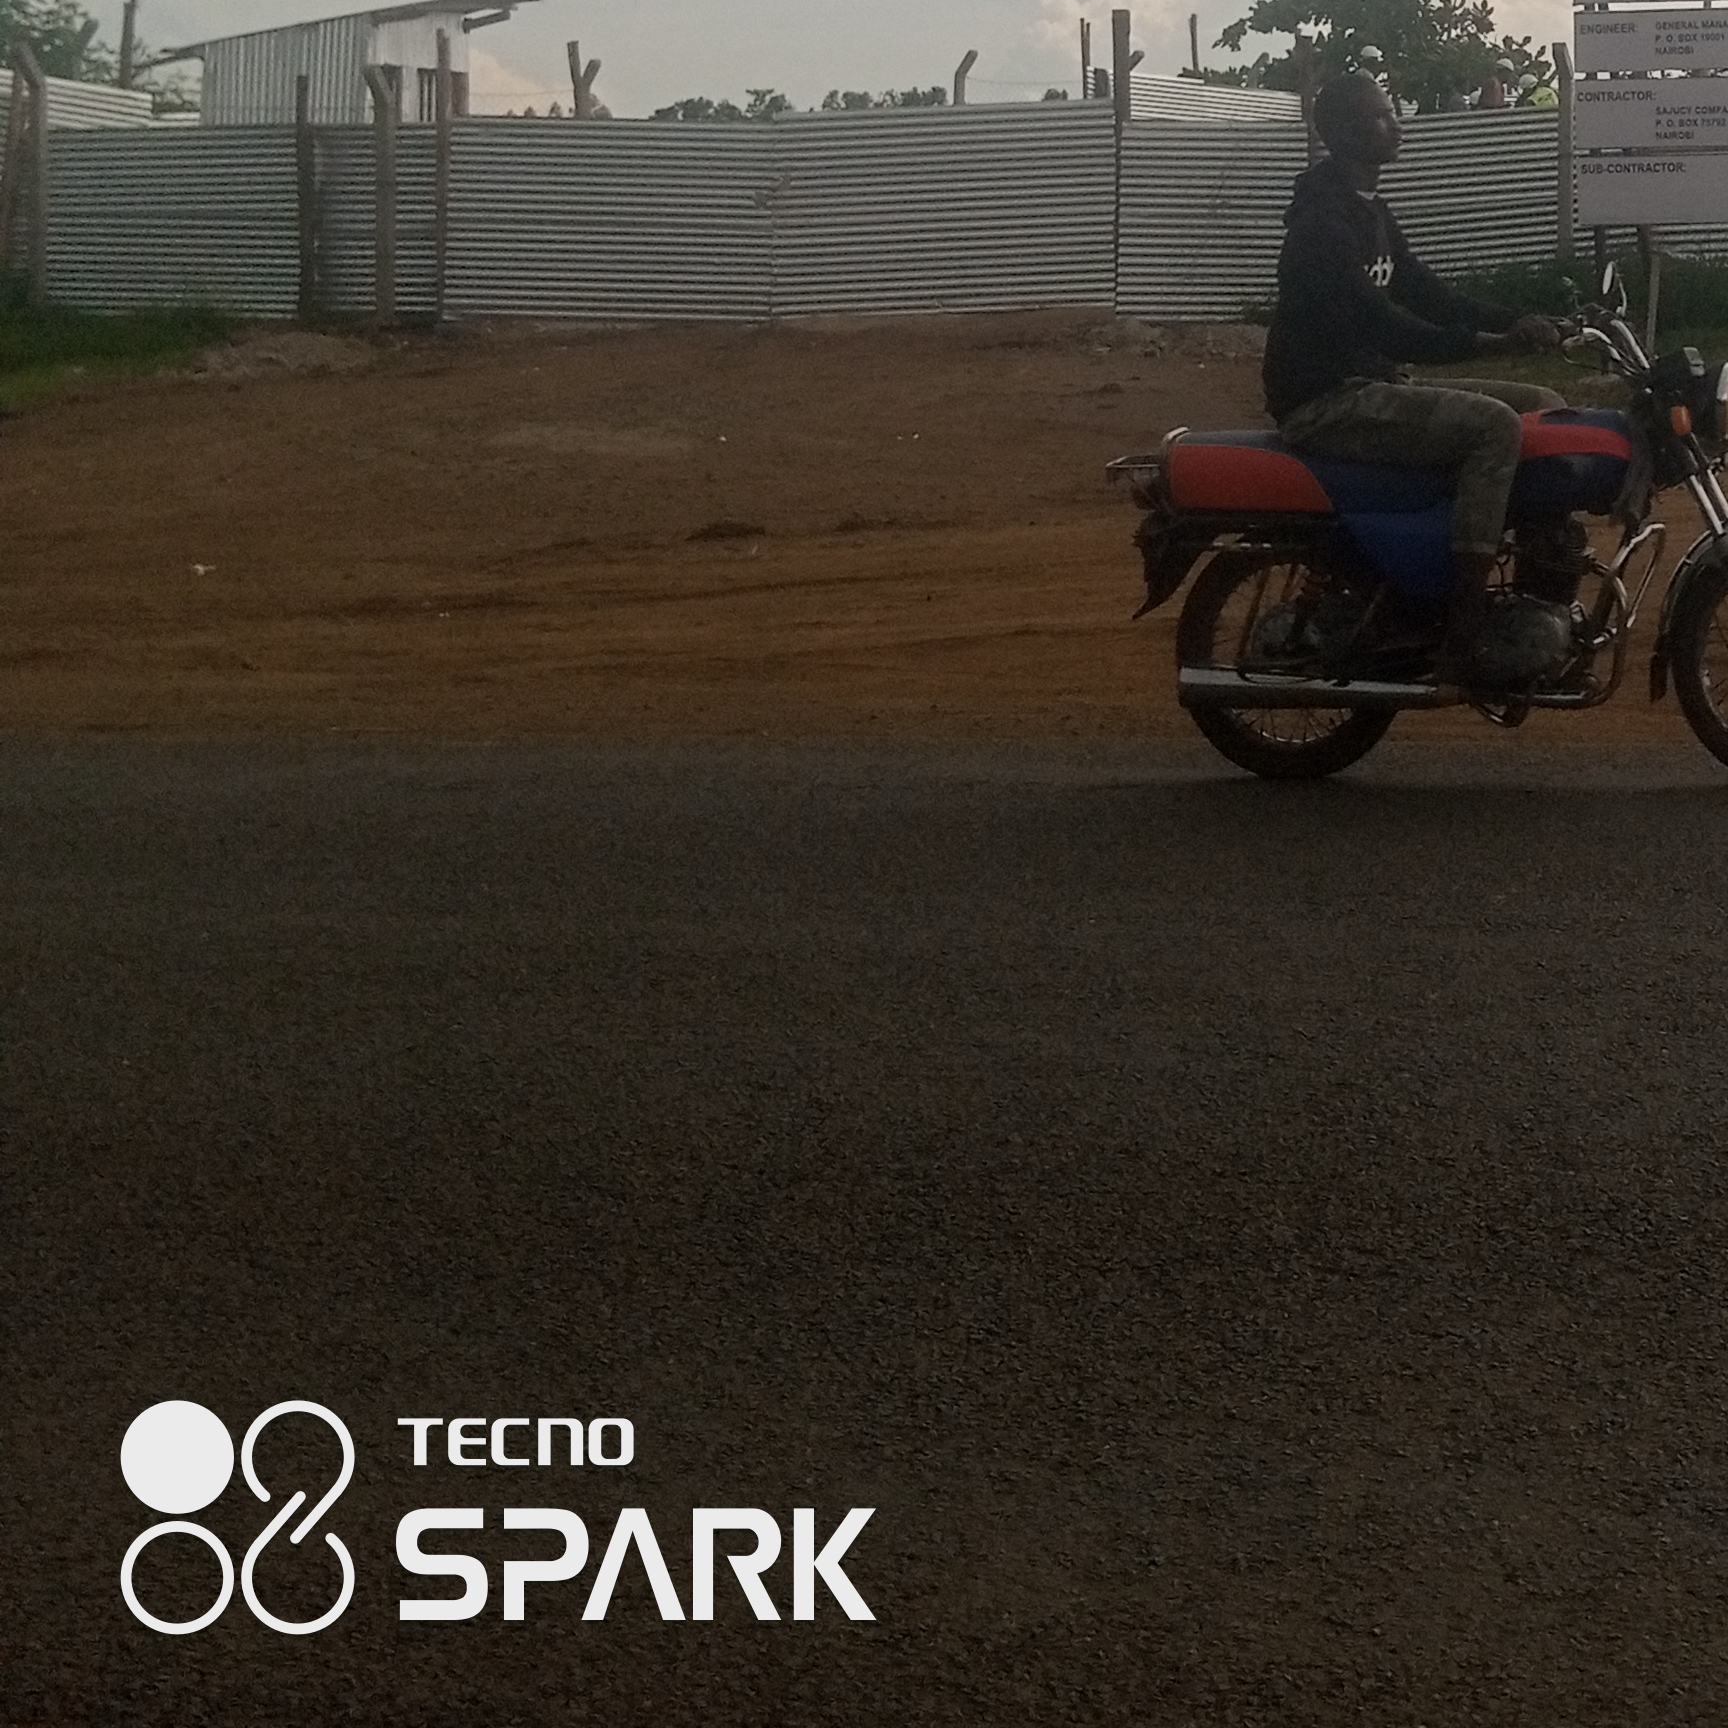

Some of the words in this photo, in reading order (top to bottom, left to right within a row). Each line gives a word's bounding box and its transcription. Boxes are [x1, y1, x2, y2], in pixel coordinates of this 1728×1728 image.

[1580, 23, 1638, 34] ENGINEER:
[1656, 20, 1698, 30] GENERAL
[1679, 33, 1698, 42] BOX
[1655, 46, 1694, 55] NAIROBI
[1577, 91, 1656, 102] CONTRACTOR:
[1679, 118, 1698, 127] BOX
[1656, 131, 1694, 140] NAIROBI
[1582, 162, 1686, 173] SUB-CONTRACTOR:
